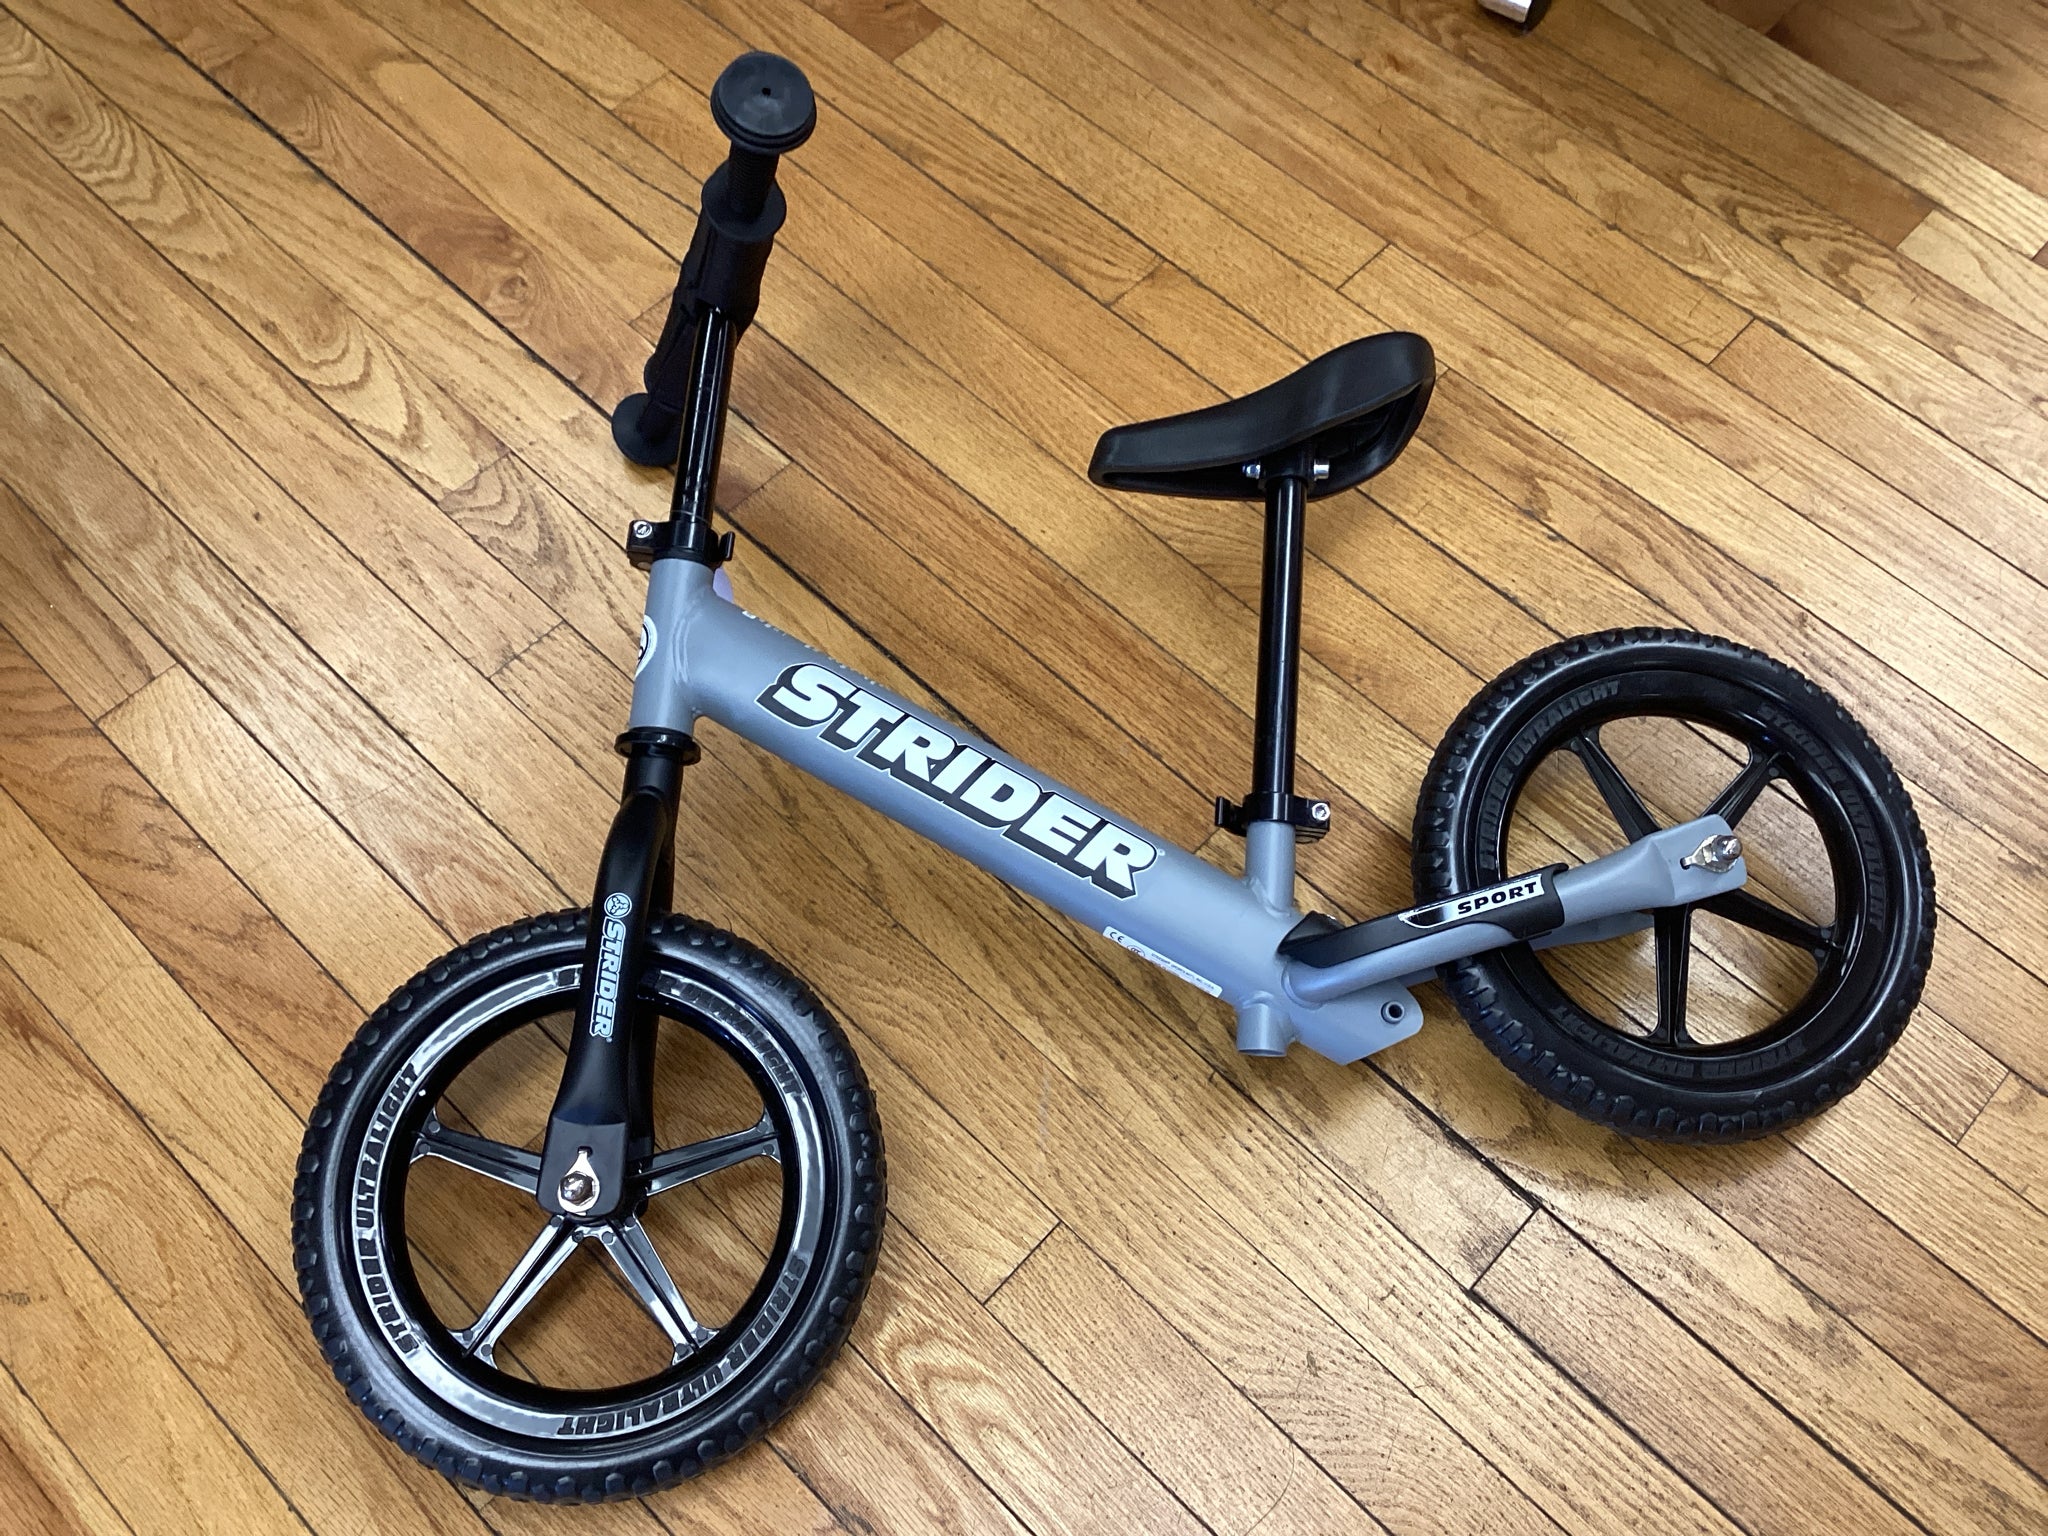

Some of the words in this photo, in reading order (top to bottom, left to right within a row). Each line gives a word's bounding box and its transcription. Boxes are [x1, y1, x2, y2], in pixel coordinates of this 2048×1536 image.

[757, 662, 1157, 899] STRIDER
[1457, 881, 1537, 914] SPORT
[590, 916, 626, 1037] STRIDER
[356, 1062, 418, 1228] ULTRALIGHT
[357, 1237, 419, 1354] STRIDER
[727, 1254, 808, 1370] STRIDER
[556, 1365, 724, 1436] ULTRALIGHT
